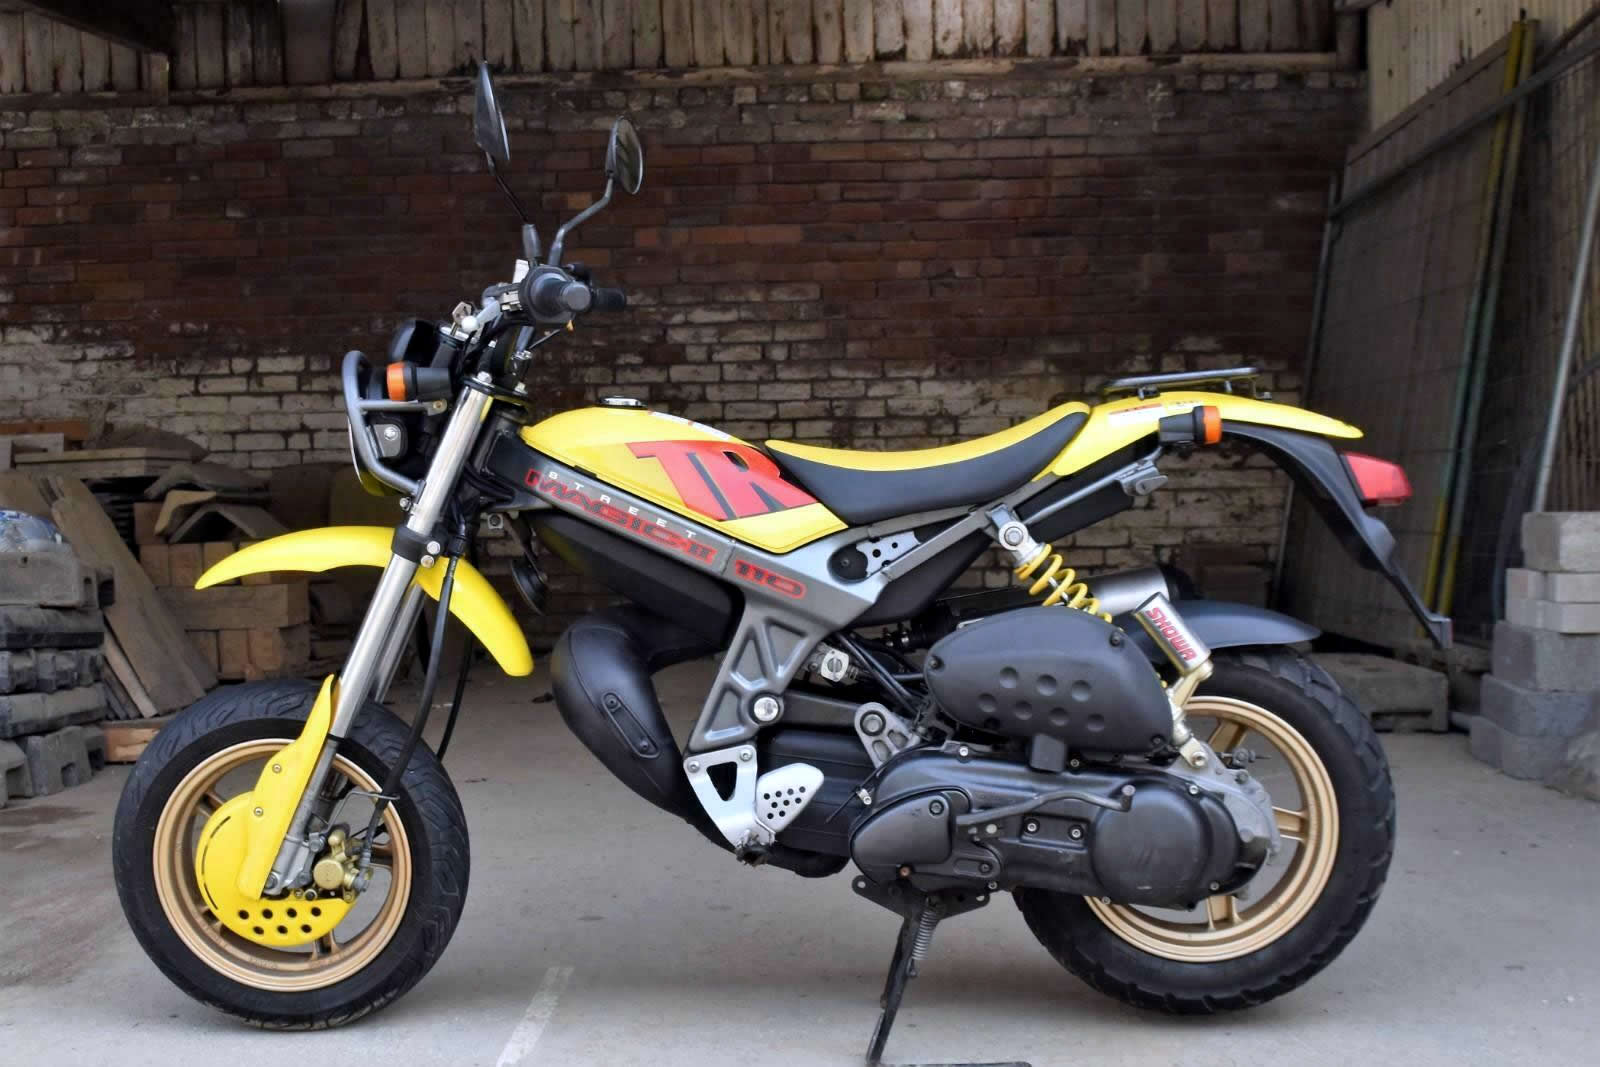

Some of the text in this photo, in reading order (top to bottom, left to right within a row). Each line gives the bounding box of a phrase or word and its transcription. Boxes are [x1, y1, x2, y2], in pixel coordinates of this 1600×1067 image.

[547, 470, 696, 539] STREET
[624, 439, 820, 522] TR
[1145, 606, 1197, 661] SHOWA
